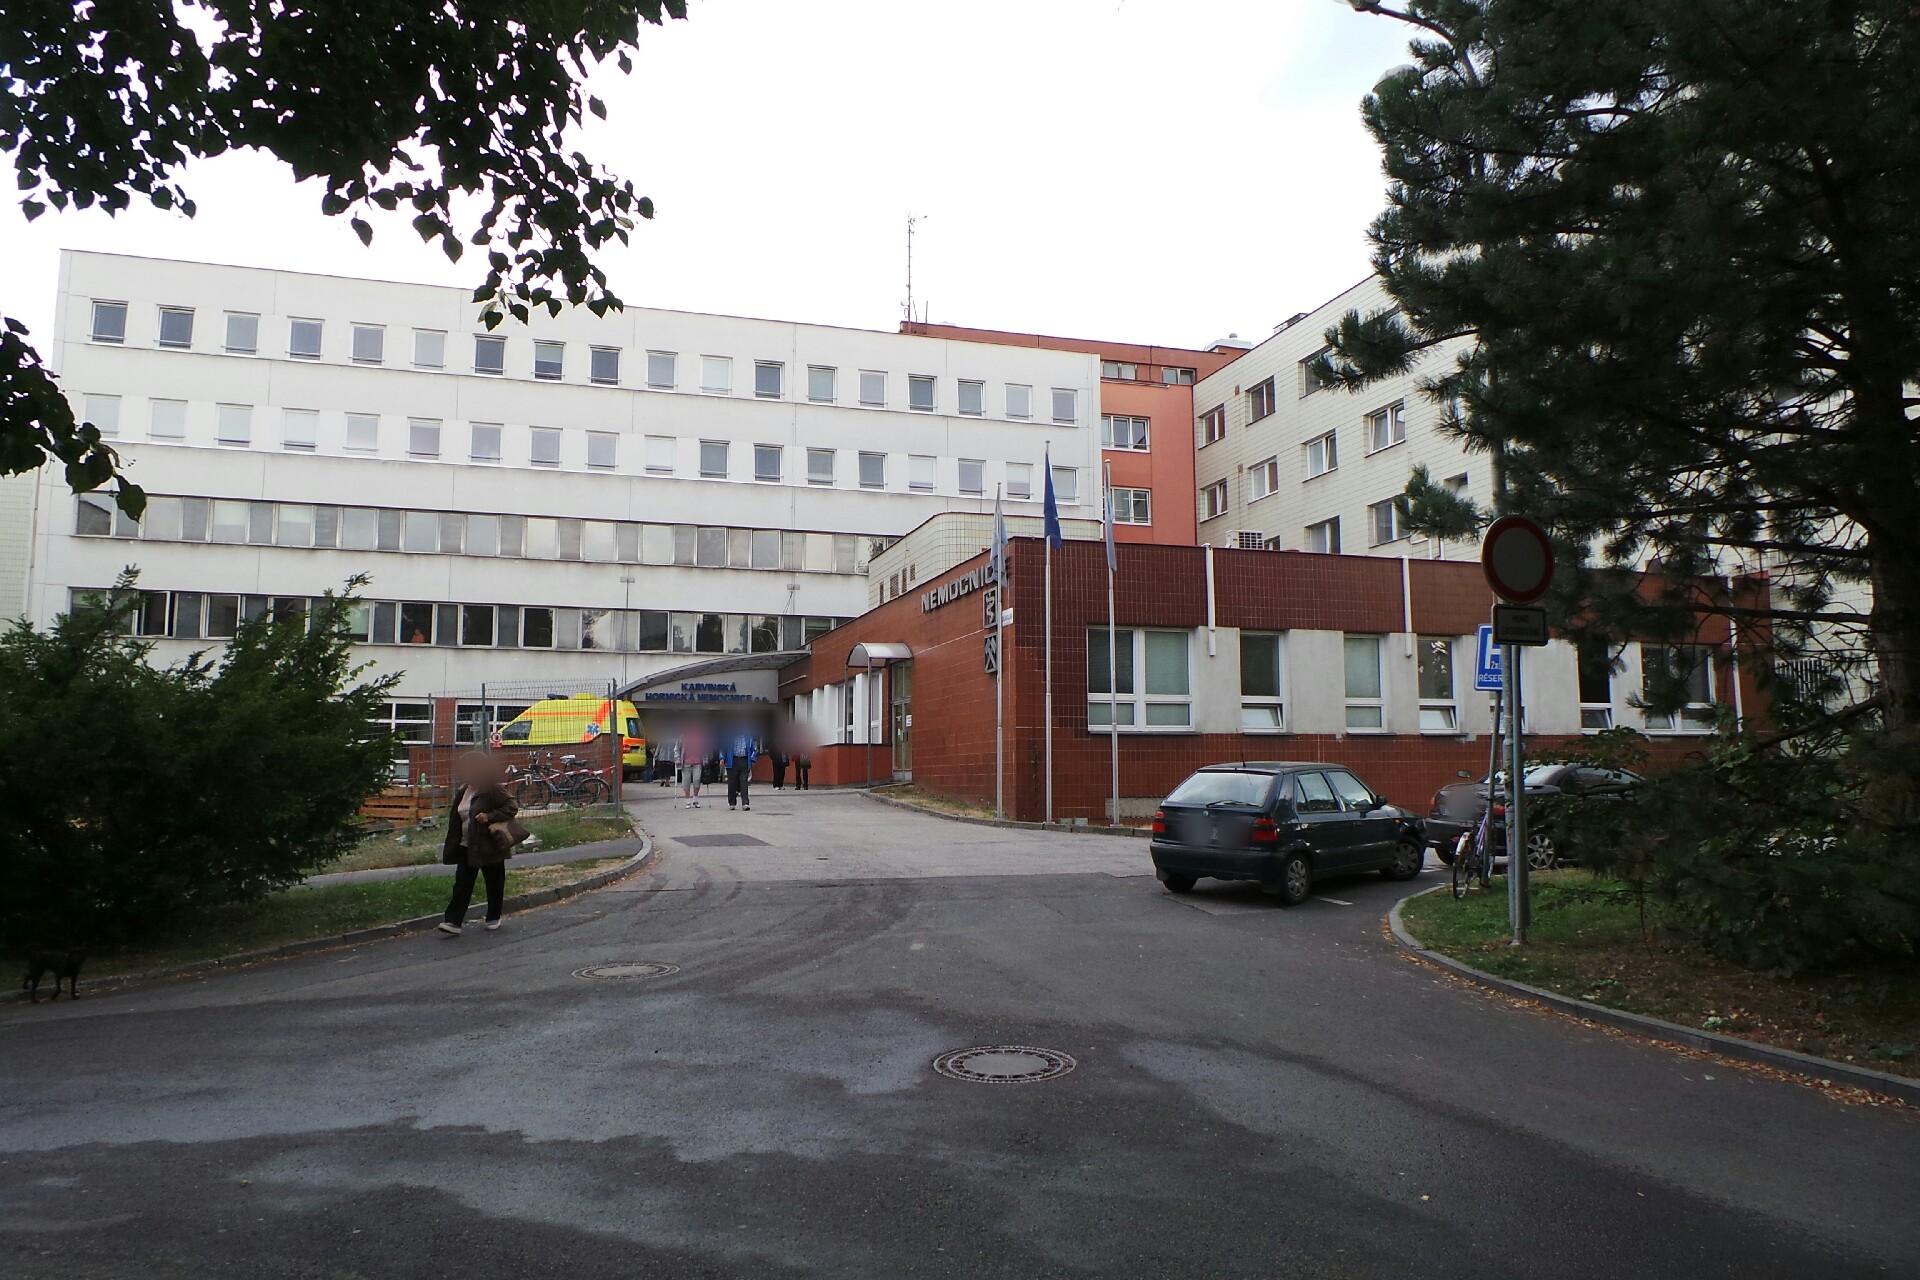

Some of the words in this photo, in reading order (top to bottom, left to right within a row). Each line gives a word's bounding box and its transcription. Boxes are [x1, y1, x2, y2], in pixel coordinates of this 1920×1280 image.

[921, 559, 1008, 613] NEMOCNIC
[1478, 673, 1503, 683] RÉSER
[681, 682, 737, 692] KARVINSKÁ
[697, 693, 752, 703] NEMOCNICE
